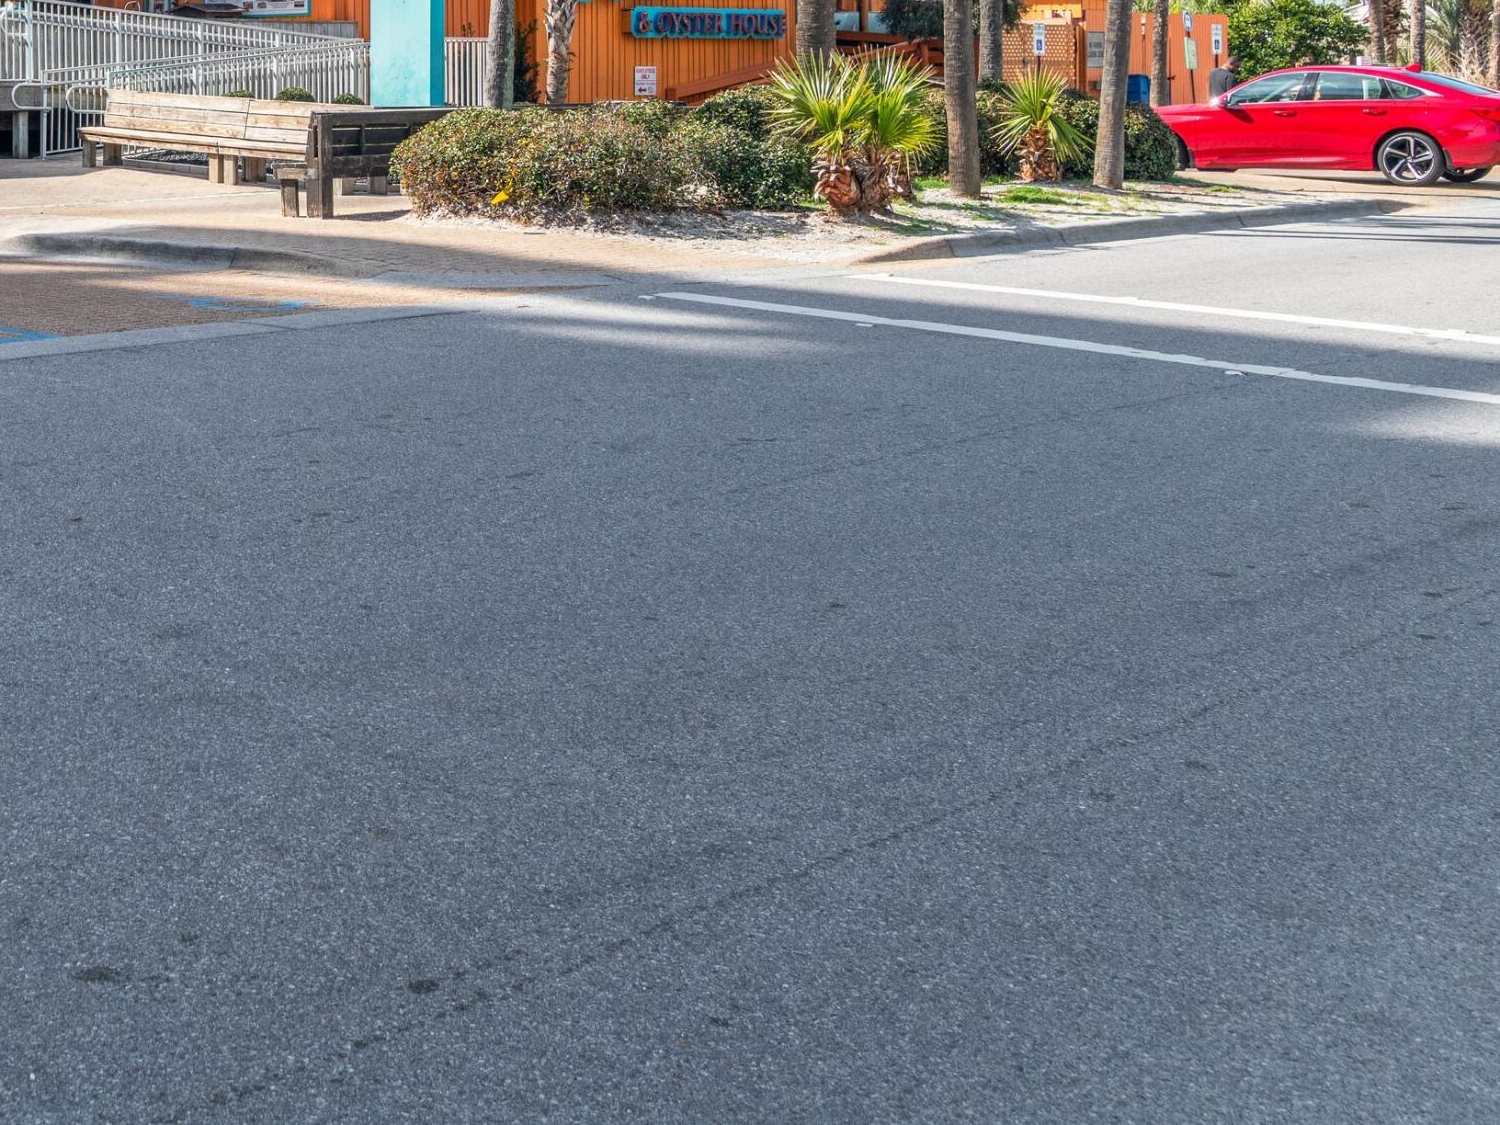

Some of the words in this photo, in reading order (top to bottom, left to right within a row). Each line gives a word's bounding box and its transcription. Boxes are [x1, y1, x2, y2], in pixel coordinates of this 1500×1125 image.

[638, 11, 652, 33] &
[657, 11, 724, 34] OYSTER
[730, 12, 788, 35] HOUSE
